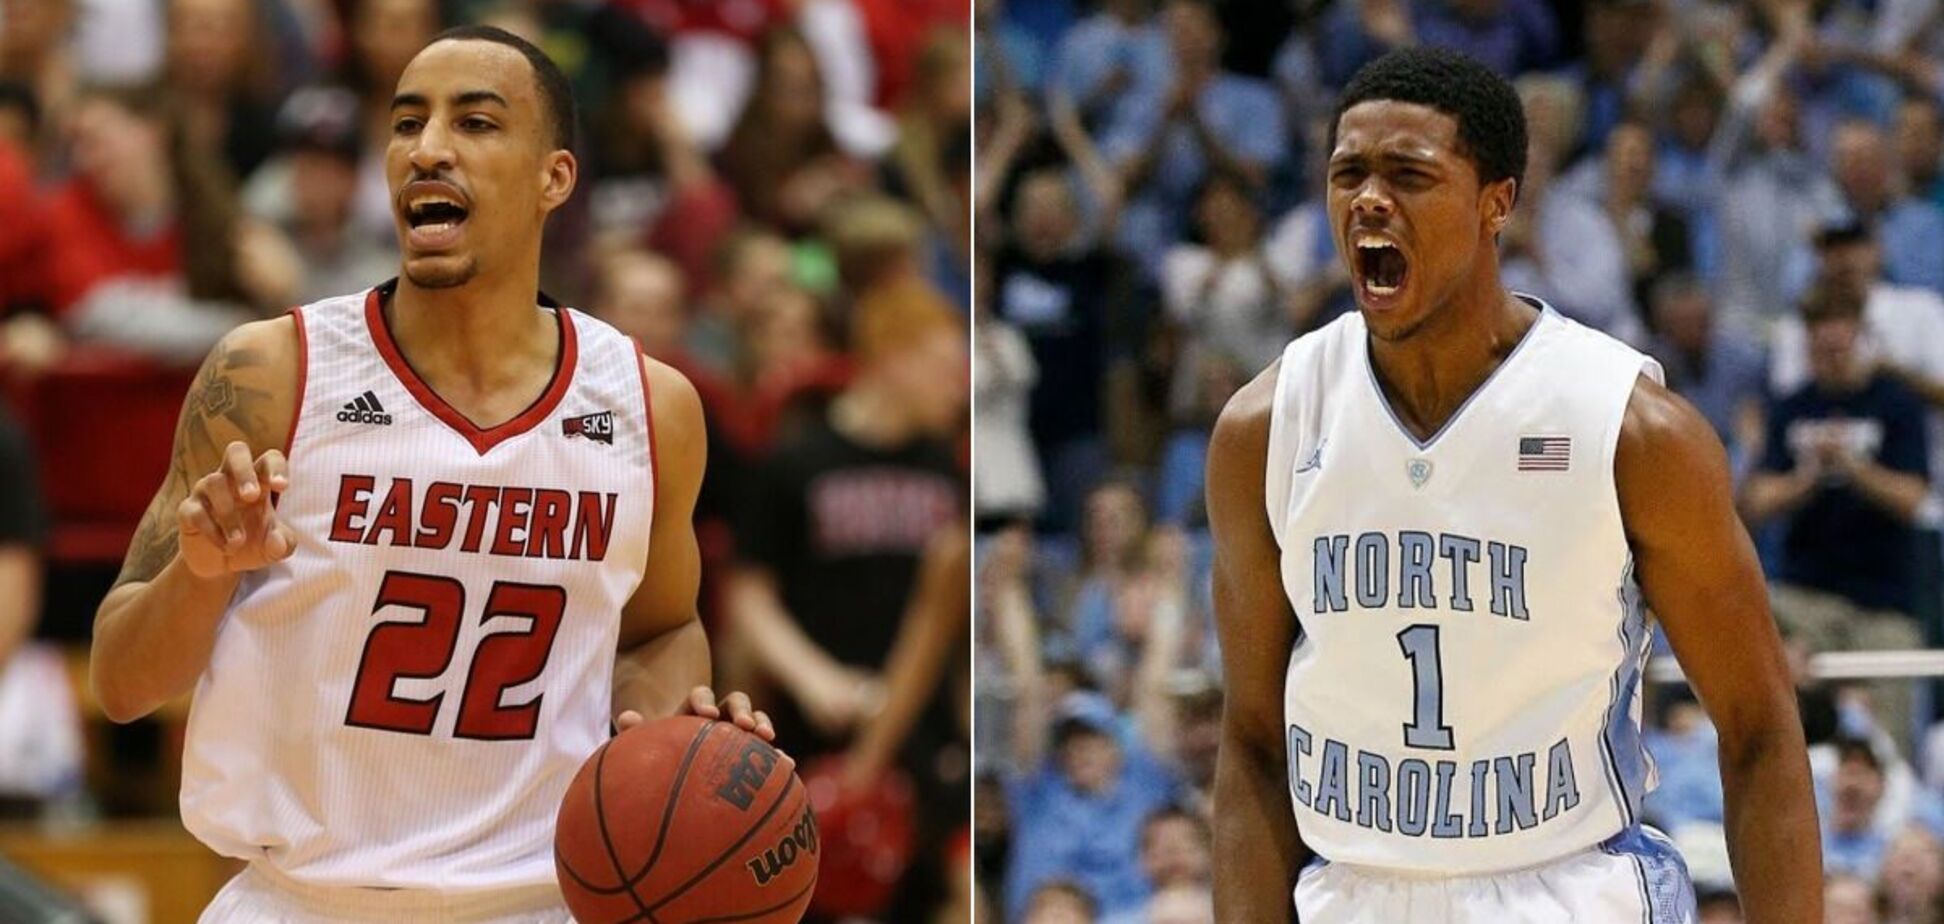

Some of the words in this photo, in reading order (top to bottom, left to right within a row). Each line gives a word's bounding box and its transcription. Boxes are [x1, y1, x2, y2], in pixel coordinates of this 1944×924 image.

[336, 409, 392, 426] adidas
[582, 414, 612, 435] SKY
[328, 474, 618, 561] EASTERN
[1313, 530, 1530, 621] NORTH
[344, 570, 567, 740] 22
[1396, 624, 1456, 750] 1
[1288, 724, 1580, 839] CAROLINA
[746, 803, 818, 885] lson
